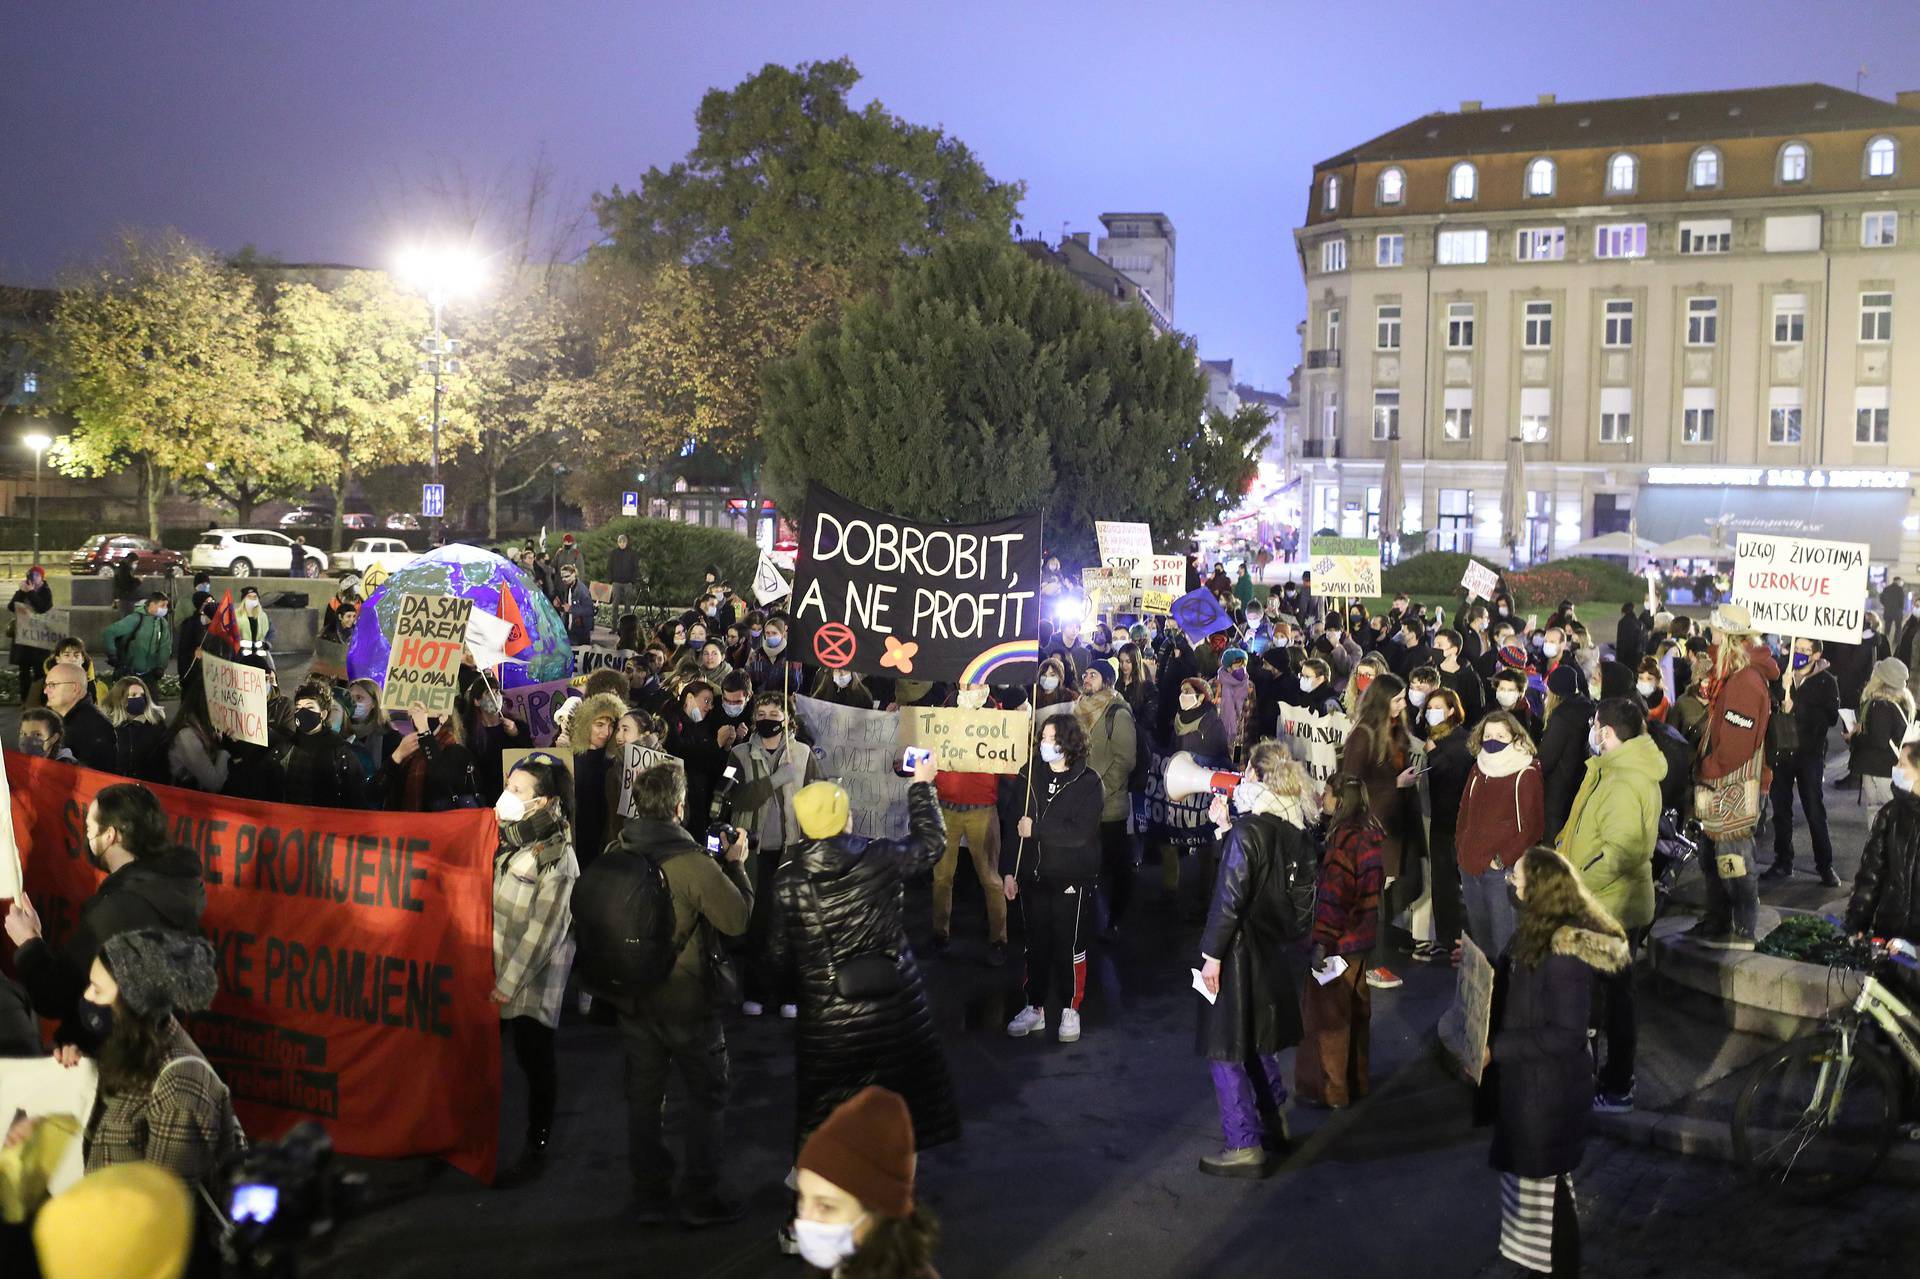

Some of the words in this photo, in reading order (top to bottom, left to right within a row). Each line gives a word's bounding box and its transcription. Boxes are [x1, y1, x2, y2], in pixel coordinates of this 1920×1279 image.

[626, 494, 634, 505] P
[812, 512, 1024, 588] DOBROBIT,
[1738, 541, 1776, 565] UZGOJ
[1789, 542, 1863, 571] ŽIVOTINJA
[1153, 559, 1183, 570] STOP
[1153, 574, 1183, 587] MEAT
[1321, 582, 1351, 593] SVAKI
[1354, 582, 1376, 594] DAN
[1748, 572, 1831, 597] UZROKUJE
[402, 596, 430, 619] DA
[432, 597, 474, 621] SAM
[796, 578, 827, 623] A
[844, 580, 898, 634] NE
[912, 587, 1035, 639] PROFIT
[1814, 605, 1859, 630] KRIZU
[397, 617, 466, 643] BAREM
[399, 638, 461, 671] HOT
[388, 666, 419, 682] KAO
[421, 670, 455, 688] OVAJ
[384, 682, 456, 709] PLANET
[919, 713, 950, 736] Too
[965, 718, 1010, 740] cool
[940, 741, 968, 760] for
[975, 742, 1017, 762] Coal
[234, 823, 431, 912] PROMJENE
[264, 935, 456, 1037] PROMJENE
